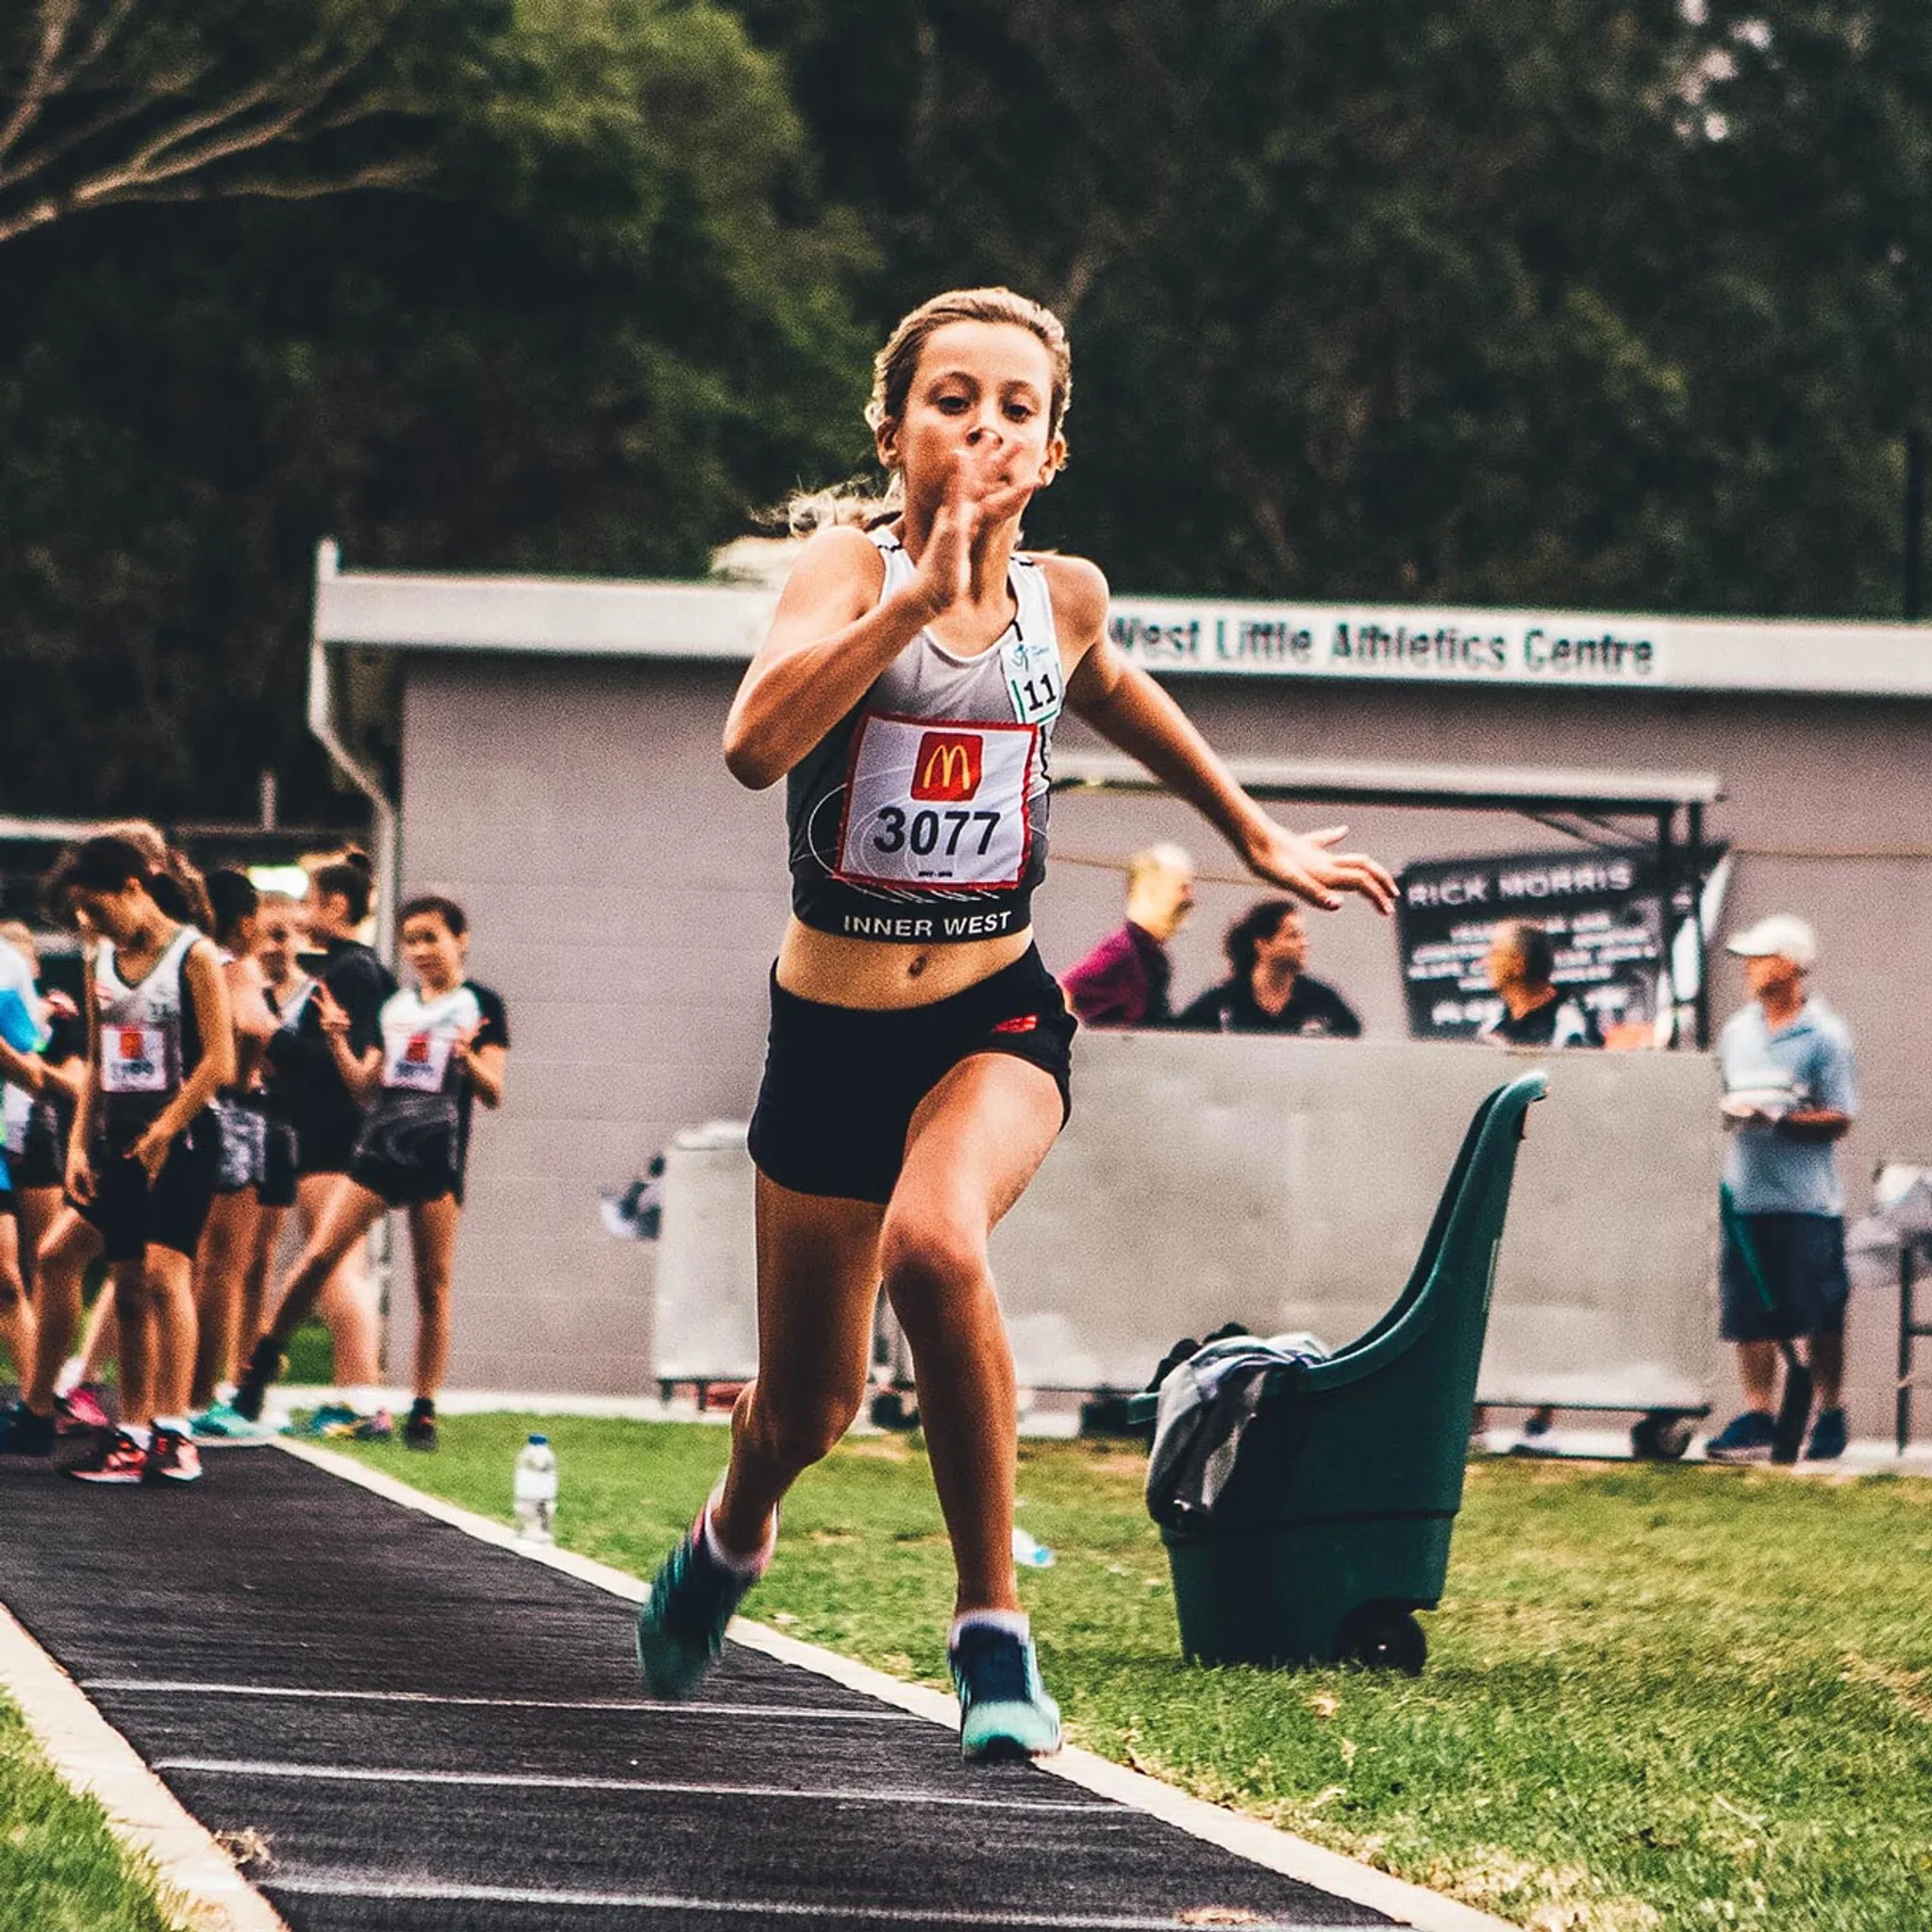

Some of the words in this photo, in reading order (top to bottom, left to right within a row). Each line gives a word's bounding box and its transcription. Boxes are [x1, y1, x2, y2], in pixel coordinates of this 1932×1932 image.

[1108, 616, 1200, 658] West
[1216, 619, 1313, 662] Little
[1331, 623, 1507, 671] Athletics
[1524, 627, 1653, 674] Centre
[1024, 673, 1057, 711] 11
[873, 806, 1002, 857] 3077
[1407, 875, 1489, 907] RICK
[1498, 862, 1632, 898] MORRIS
[843, 915, 933, 938] INNER
[944, 910, 1012, 936] WEST
